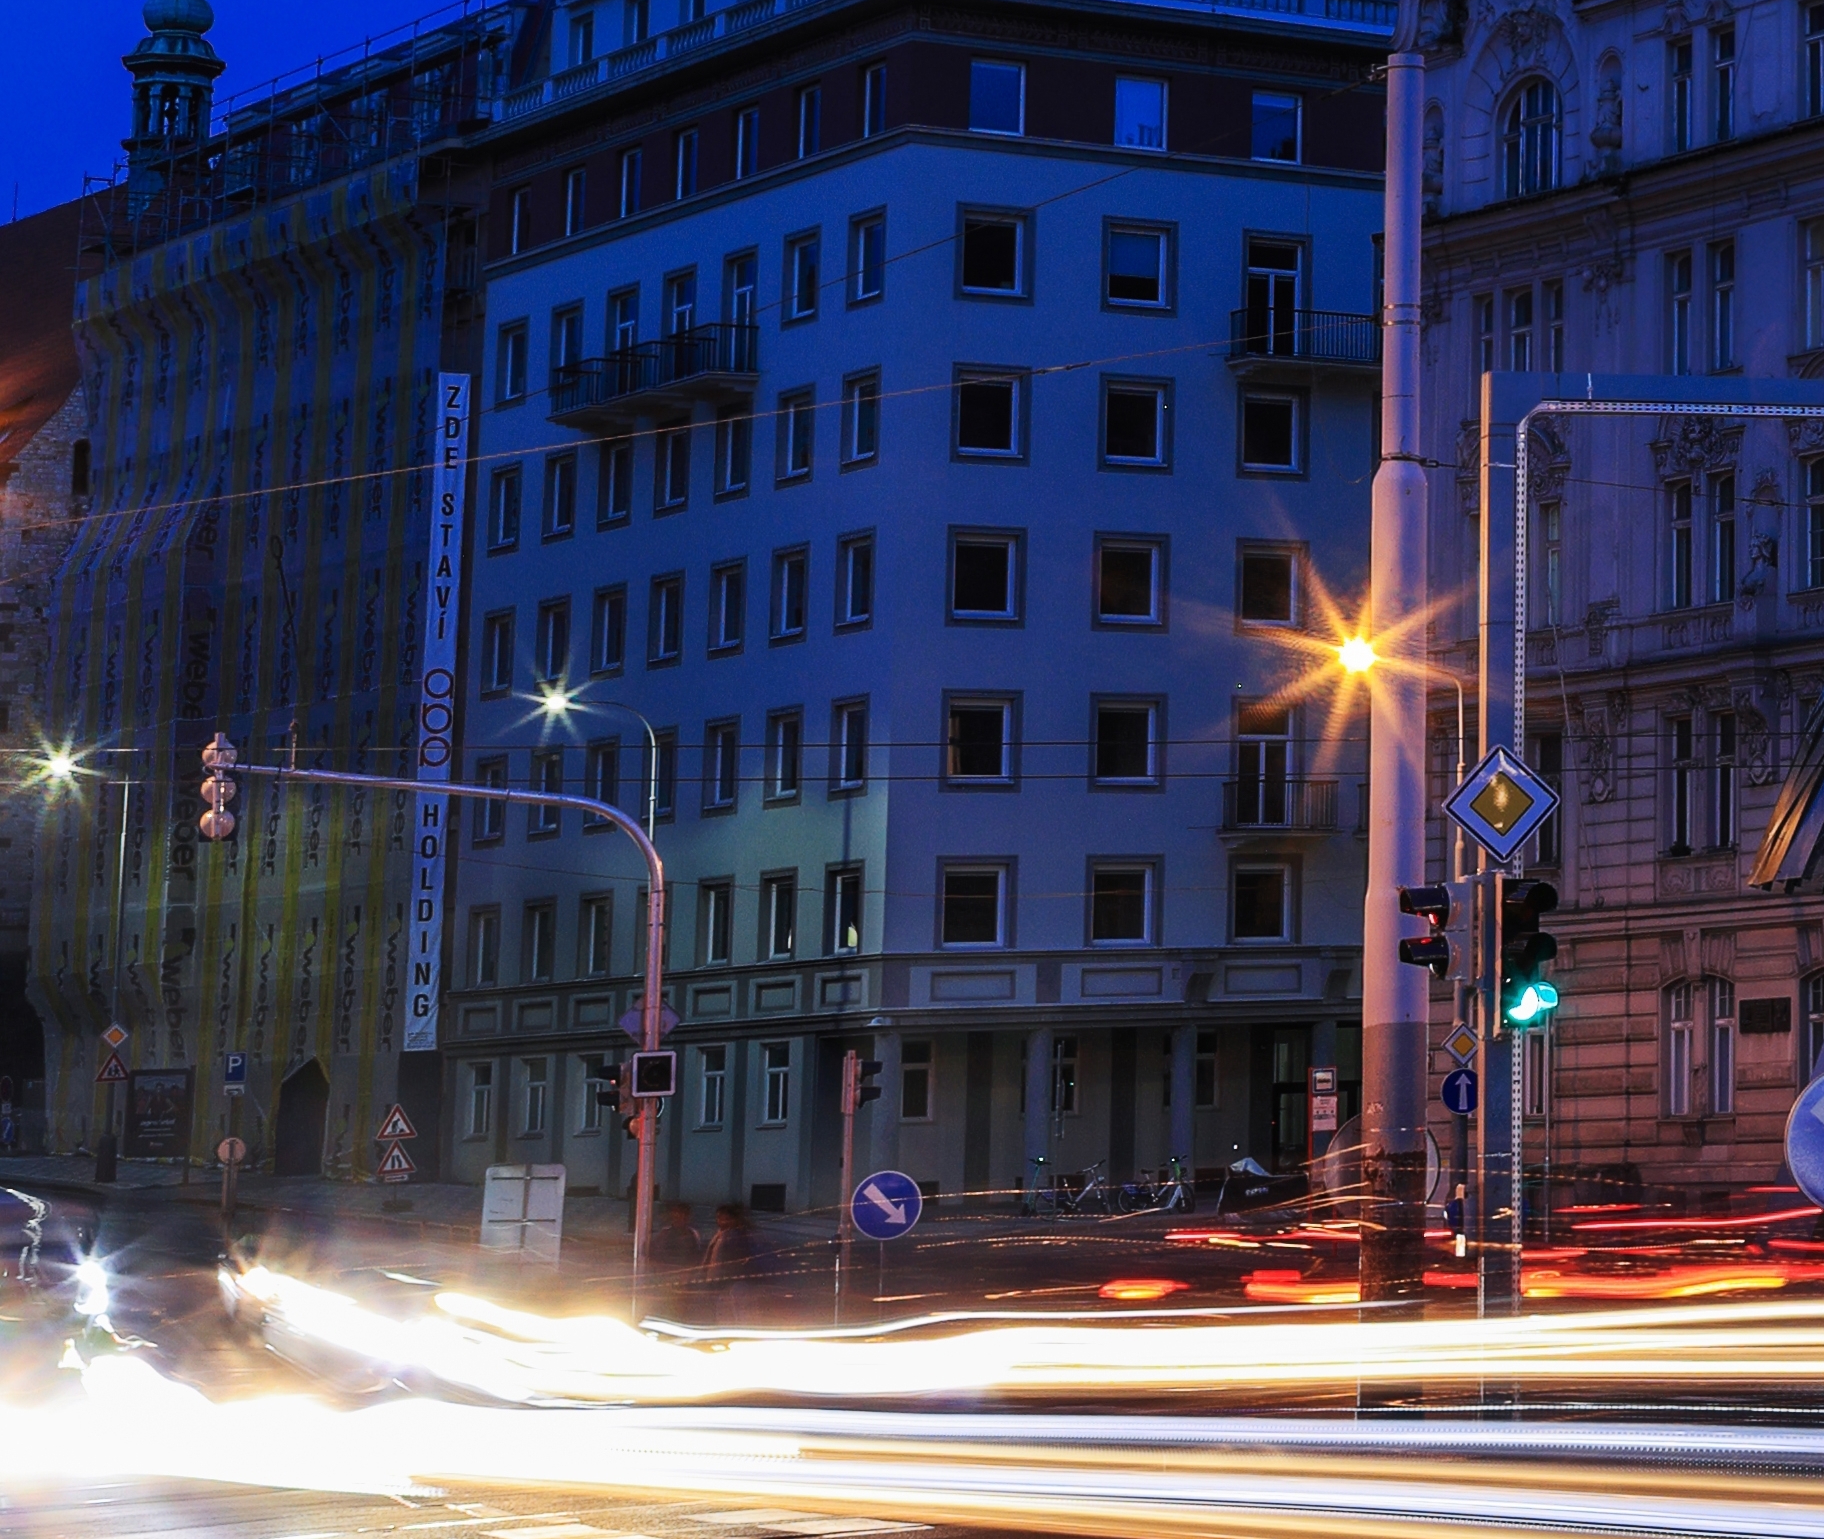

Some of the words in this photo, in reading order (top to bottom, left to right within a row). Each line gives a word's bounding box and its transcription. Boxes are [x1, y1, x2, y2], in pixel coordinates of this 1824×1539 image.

[444, 385, 461, 470] ZDE
[436, 492, 455, 640] STAVÍ
[413, 803, 439, 1018] HOLDING
[340, 933, 358, 1054] weber
[382, 931, 400, 1054] weber
[228, 1055, 243, 1074] P
